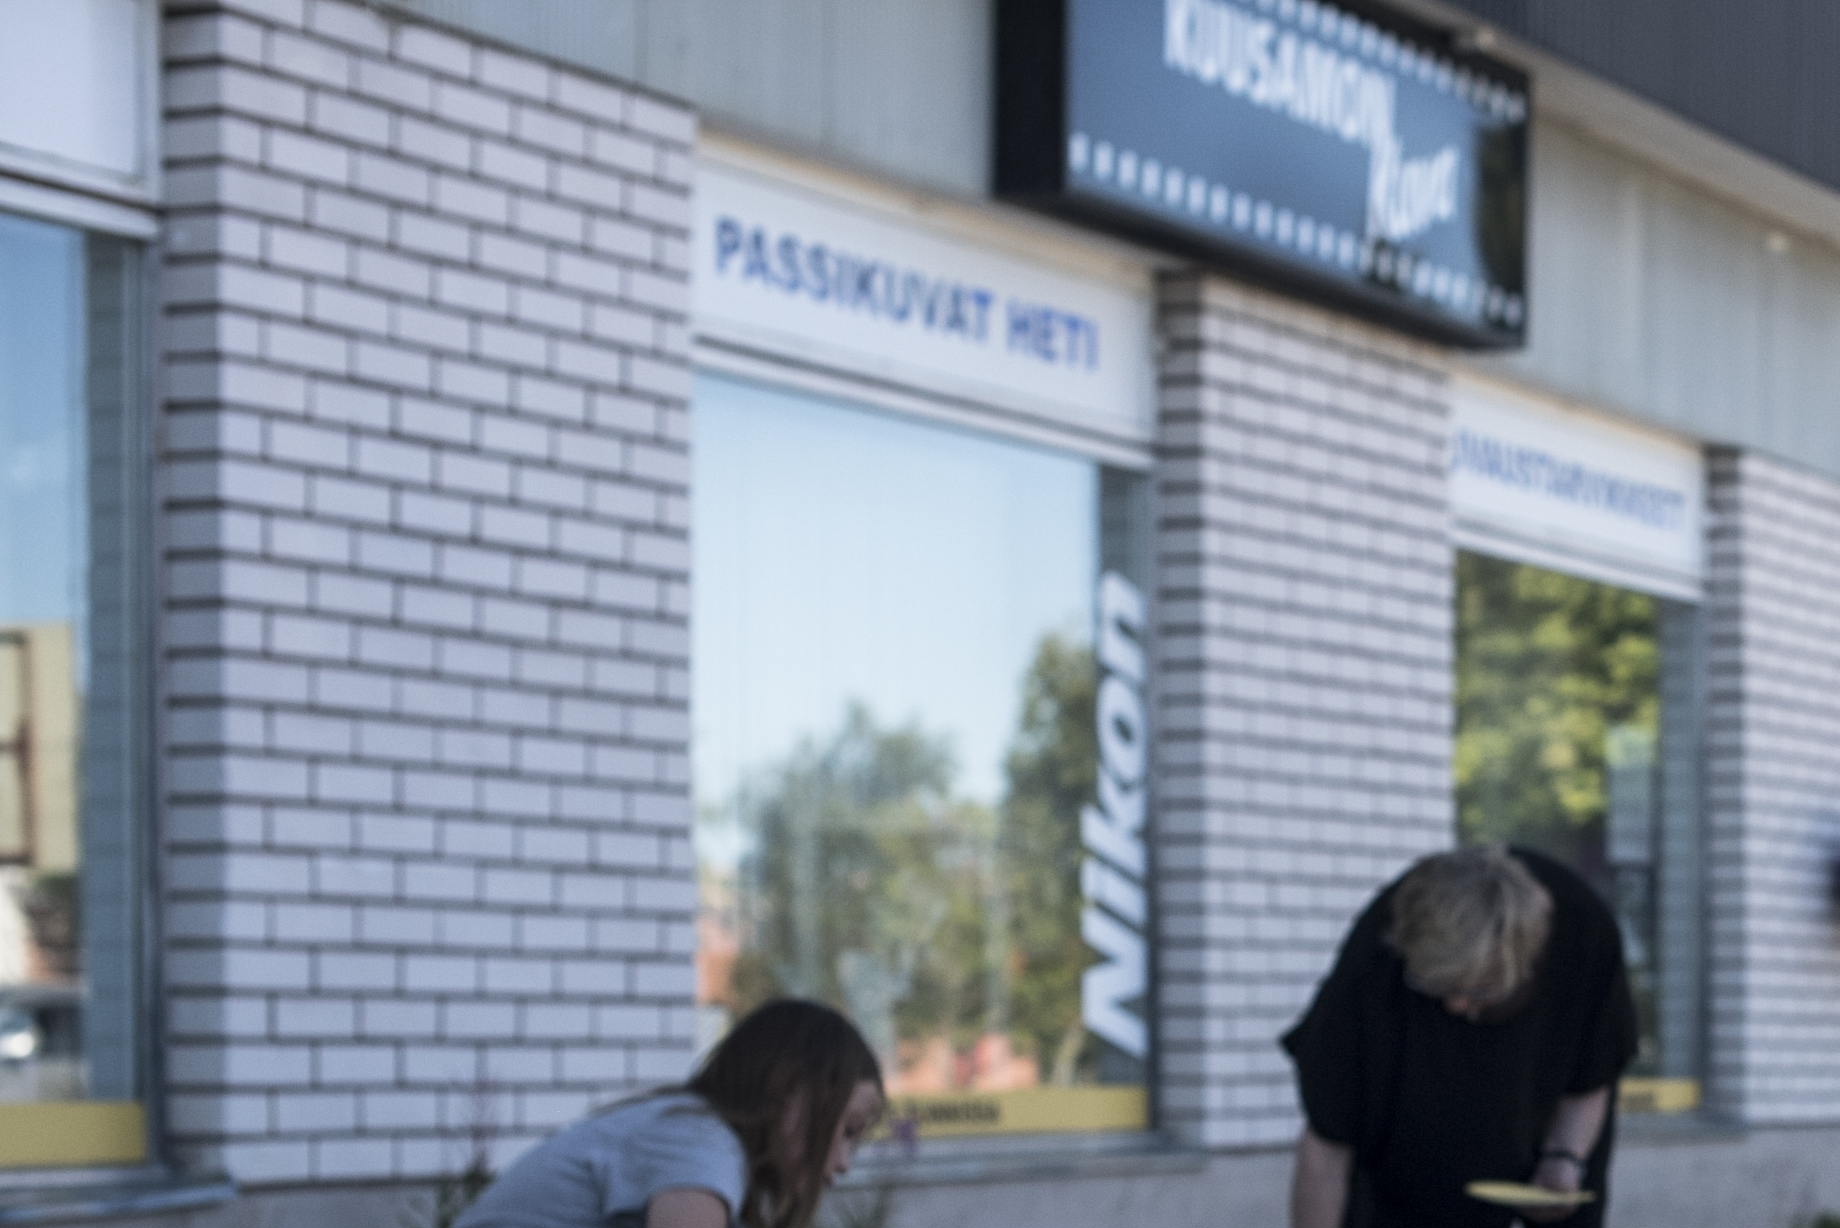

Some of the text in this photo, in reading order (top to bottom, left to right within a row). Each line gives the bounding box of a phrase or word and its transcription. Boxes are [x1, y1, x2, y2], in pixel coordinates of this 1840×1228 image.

[1163, 0, 1396, 149] KUUSAMON
[714, 215, 1100, 373] PASSIKUVAT HETI
[1081, 570, 1148, 1059] Nikon
